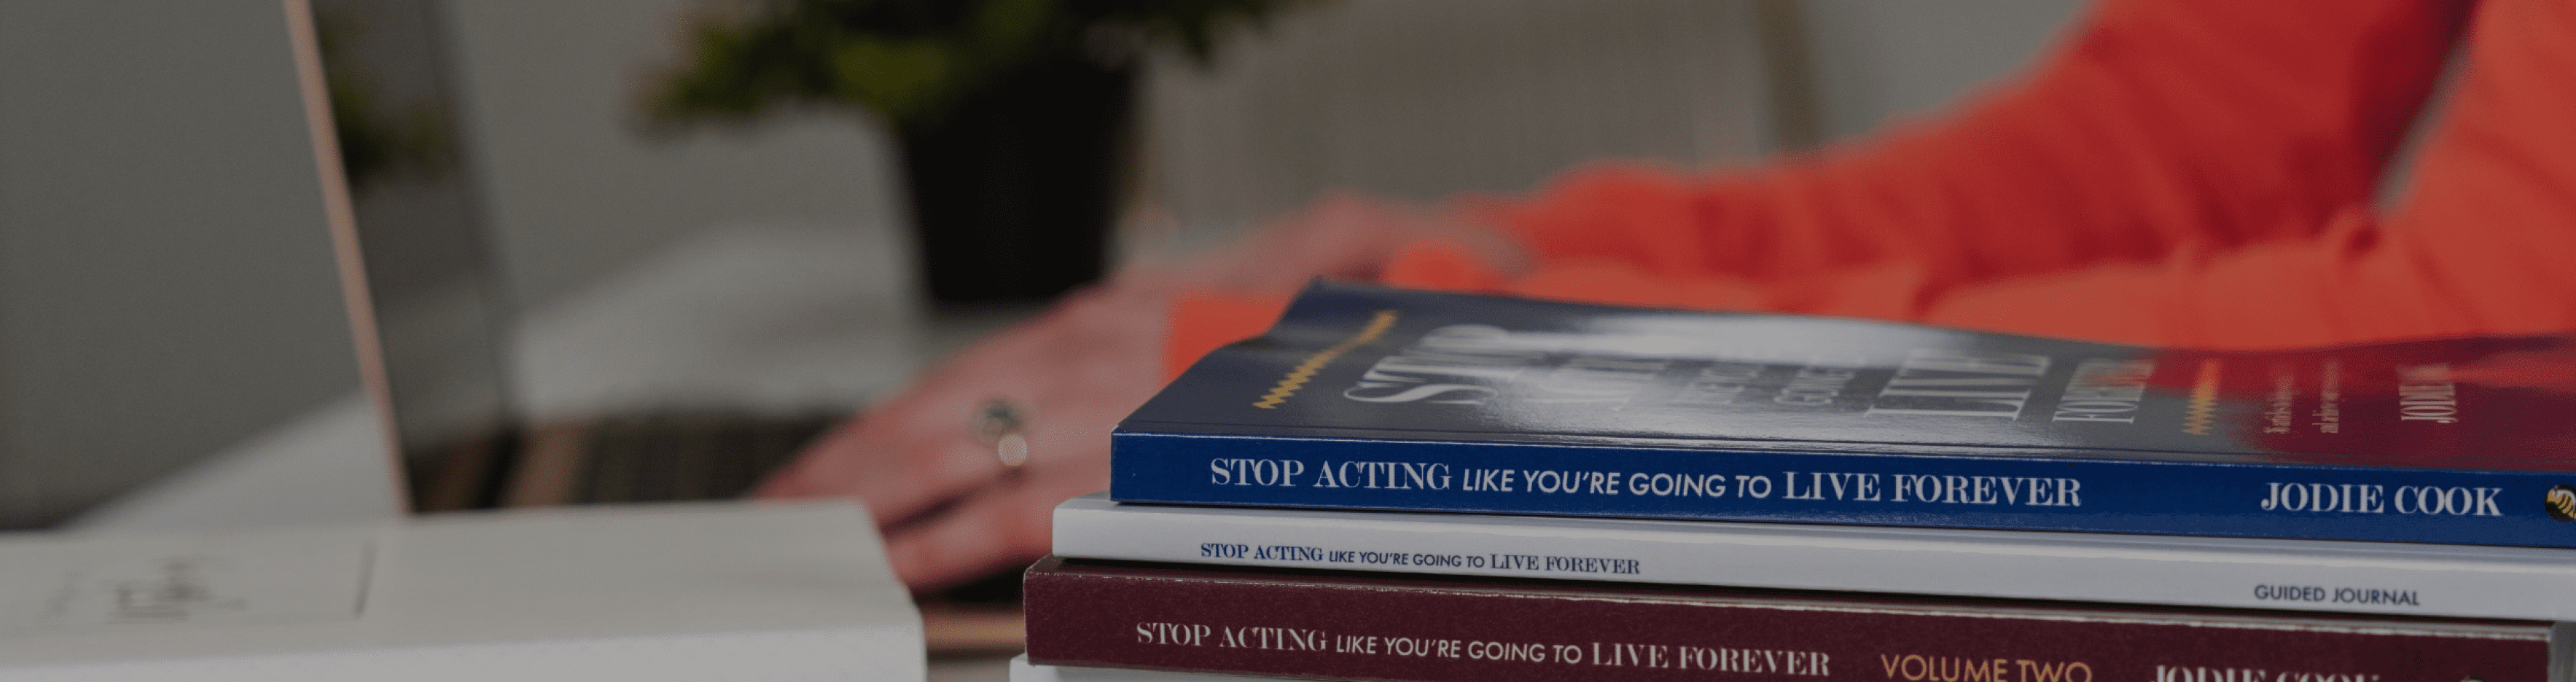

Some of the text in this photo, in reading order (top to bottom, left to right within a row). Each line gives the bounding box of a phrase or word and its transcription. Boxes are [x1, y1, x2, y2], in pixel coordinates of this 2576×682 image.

[1864, 350, 2050, 421] LIVE
[1211, 458, 2081, 506] STOP ACTING LIKE YOU'RE GOING TO LIVE FOREVER
[2260, 482, 2504, 516] JODIE COOK
[1201, 543, 1639, 574] STOP ACTING LIKE YOU'RE GOING TO LIVE FOREVER
[2254, 584, 2420, 605] GUIDED JOURNAL
[1136, 622, 1830, 676] STOP ACTING LIKE YOU'RE GOING TO LIVE FOREVER
[1881, 654, 2093, 682] VOLUME TWO
